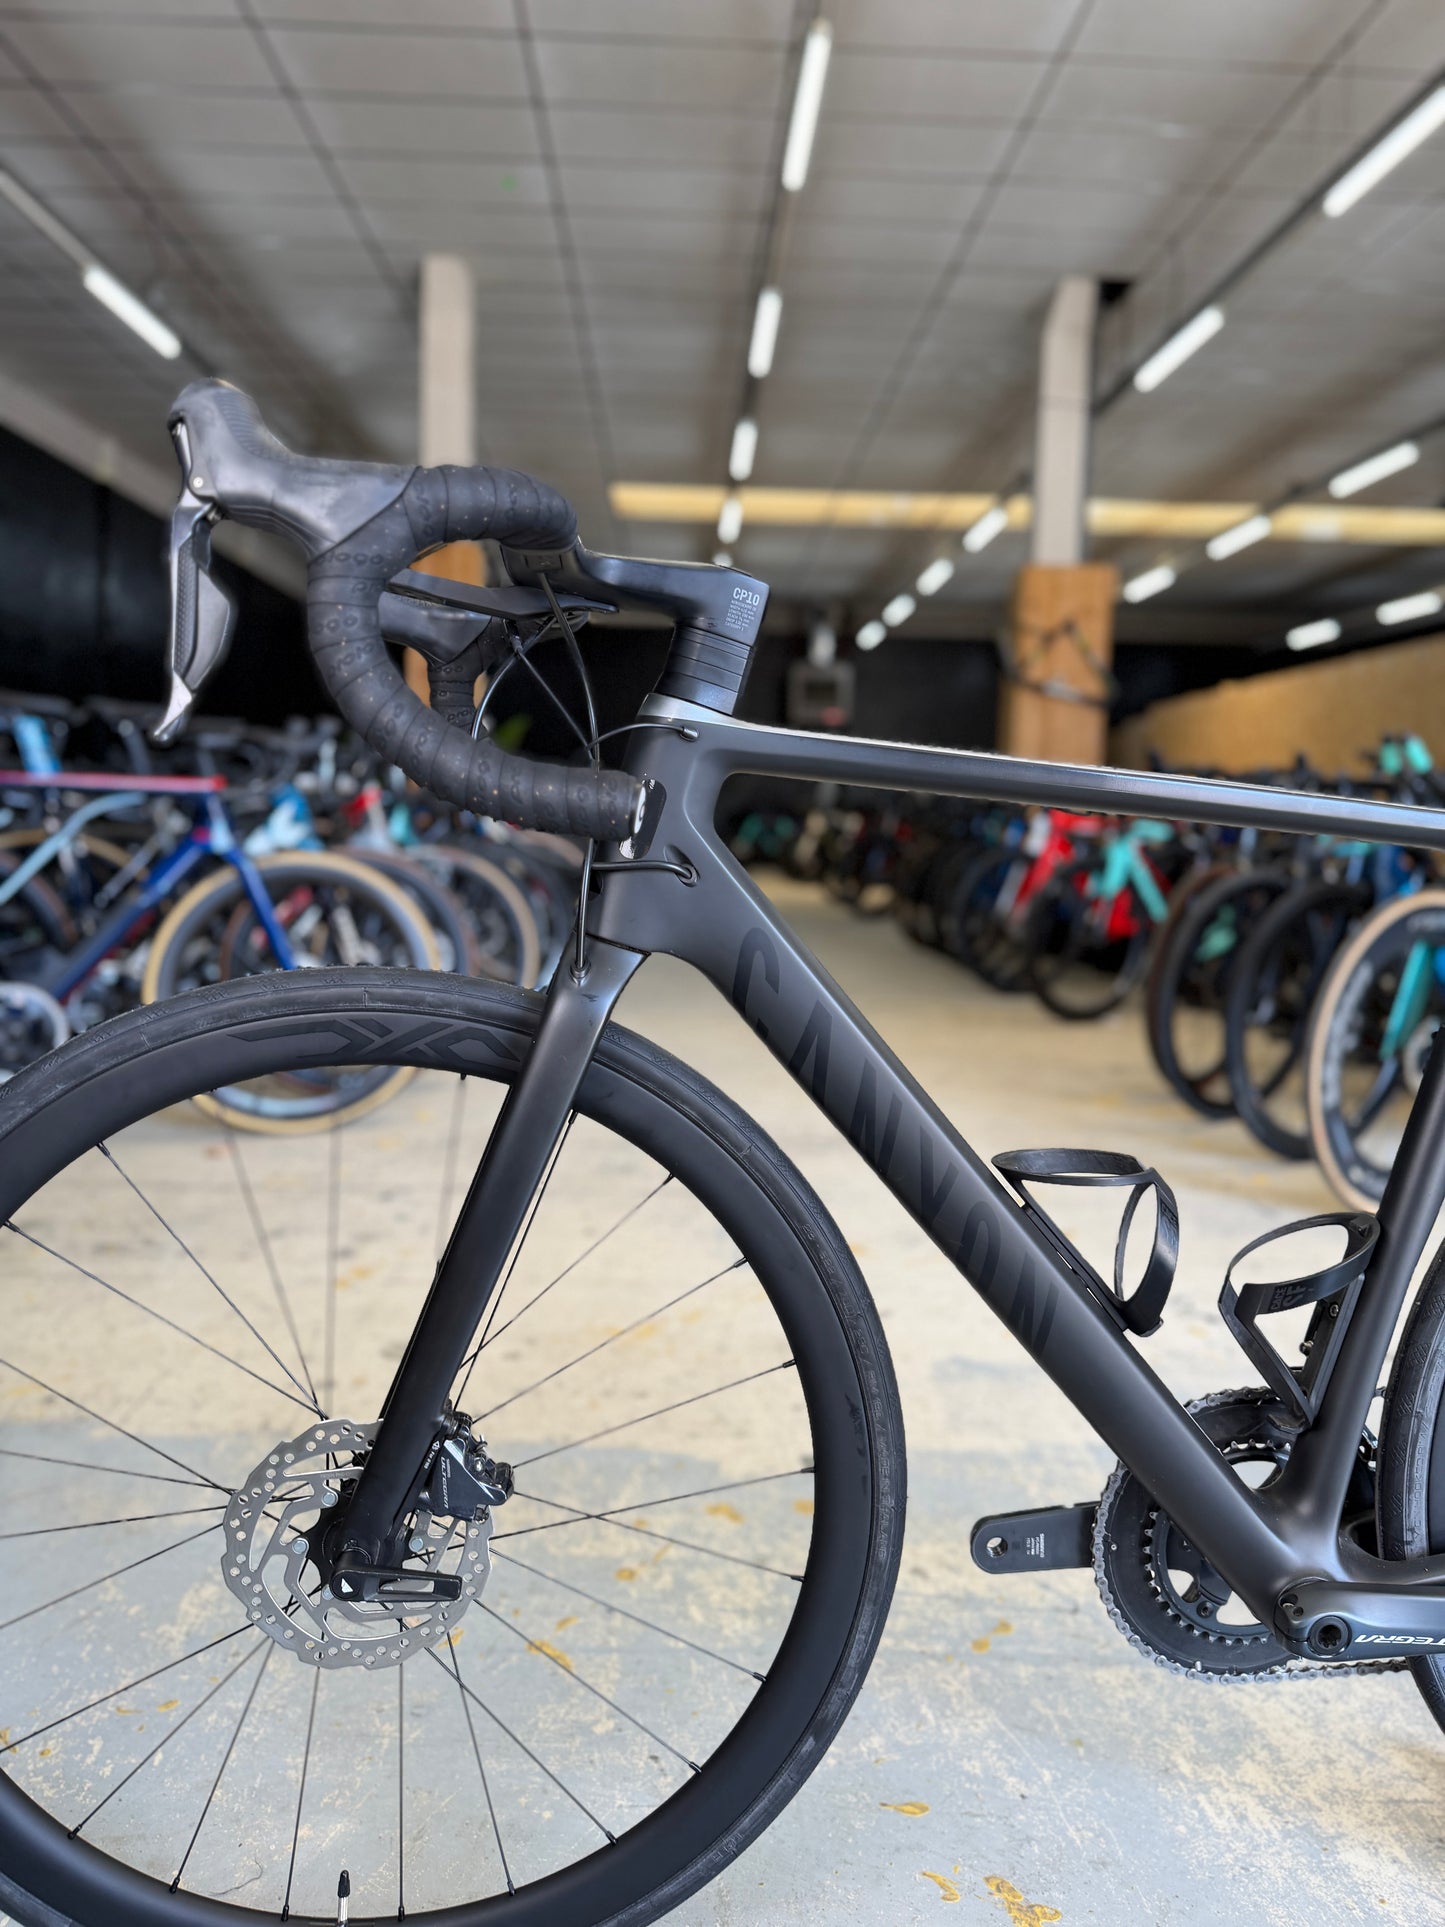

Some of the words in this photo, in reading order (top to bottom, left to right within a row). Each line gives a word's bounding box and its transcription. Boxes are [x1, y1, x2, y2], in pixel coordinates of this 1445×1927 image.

[732, 587, 760, 606] CP10
[732, 927, 1060, 1358] CANYON
[440, 1456, 449, 1509] ULTEGRA
